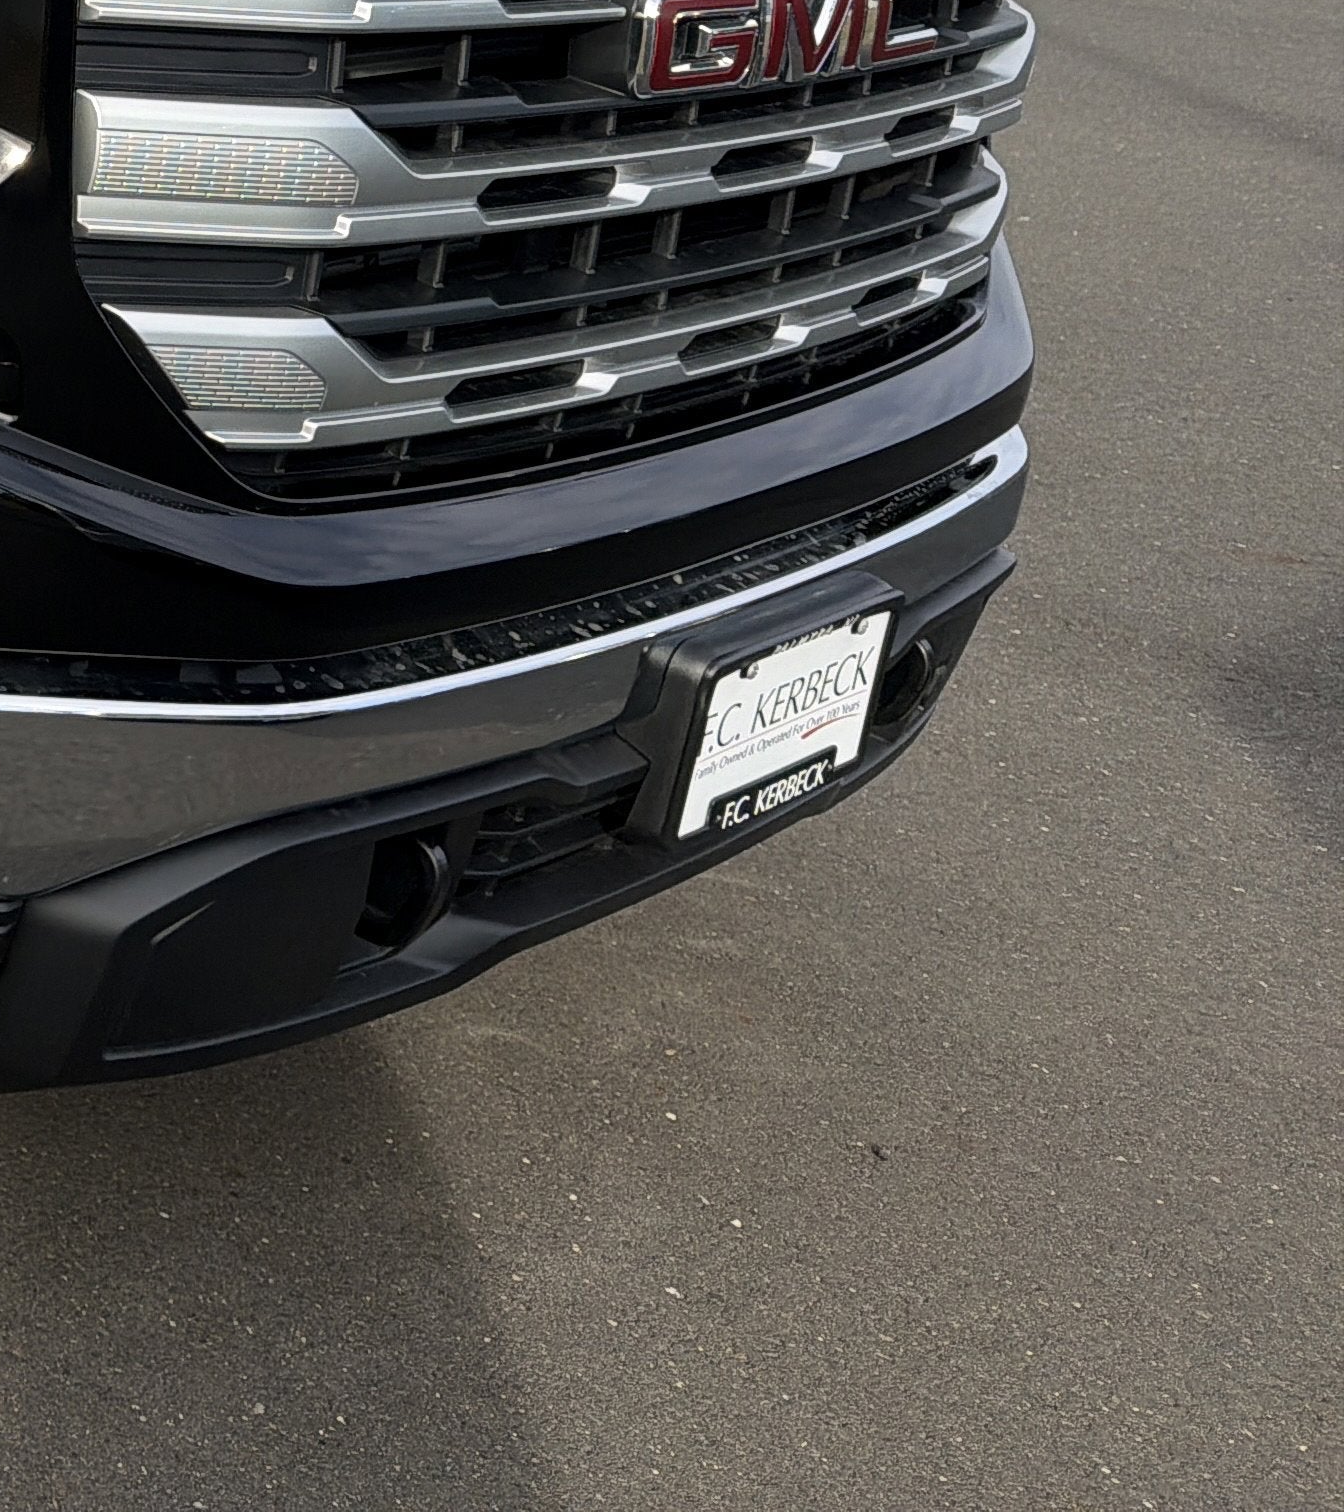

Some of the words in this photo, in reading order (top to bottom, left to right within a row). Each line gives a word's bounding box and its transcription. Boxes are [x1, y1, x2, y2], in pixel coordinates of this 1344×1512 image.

[750, 646, 875, 734] KERBECK
[806, 714, 825, 731] Over
[842, 701, 861, 716] Years
[753, 758, 828, 816] KERBECK
